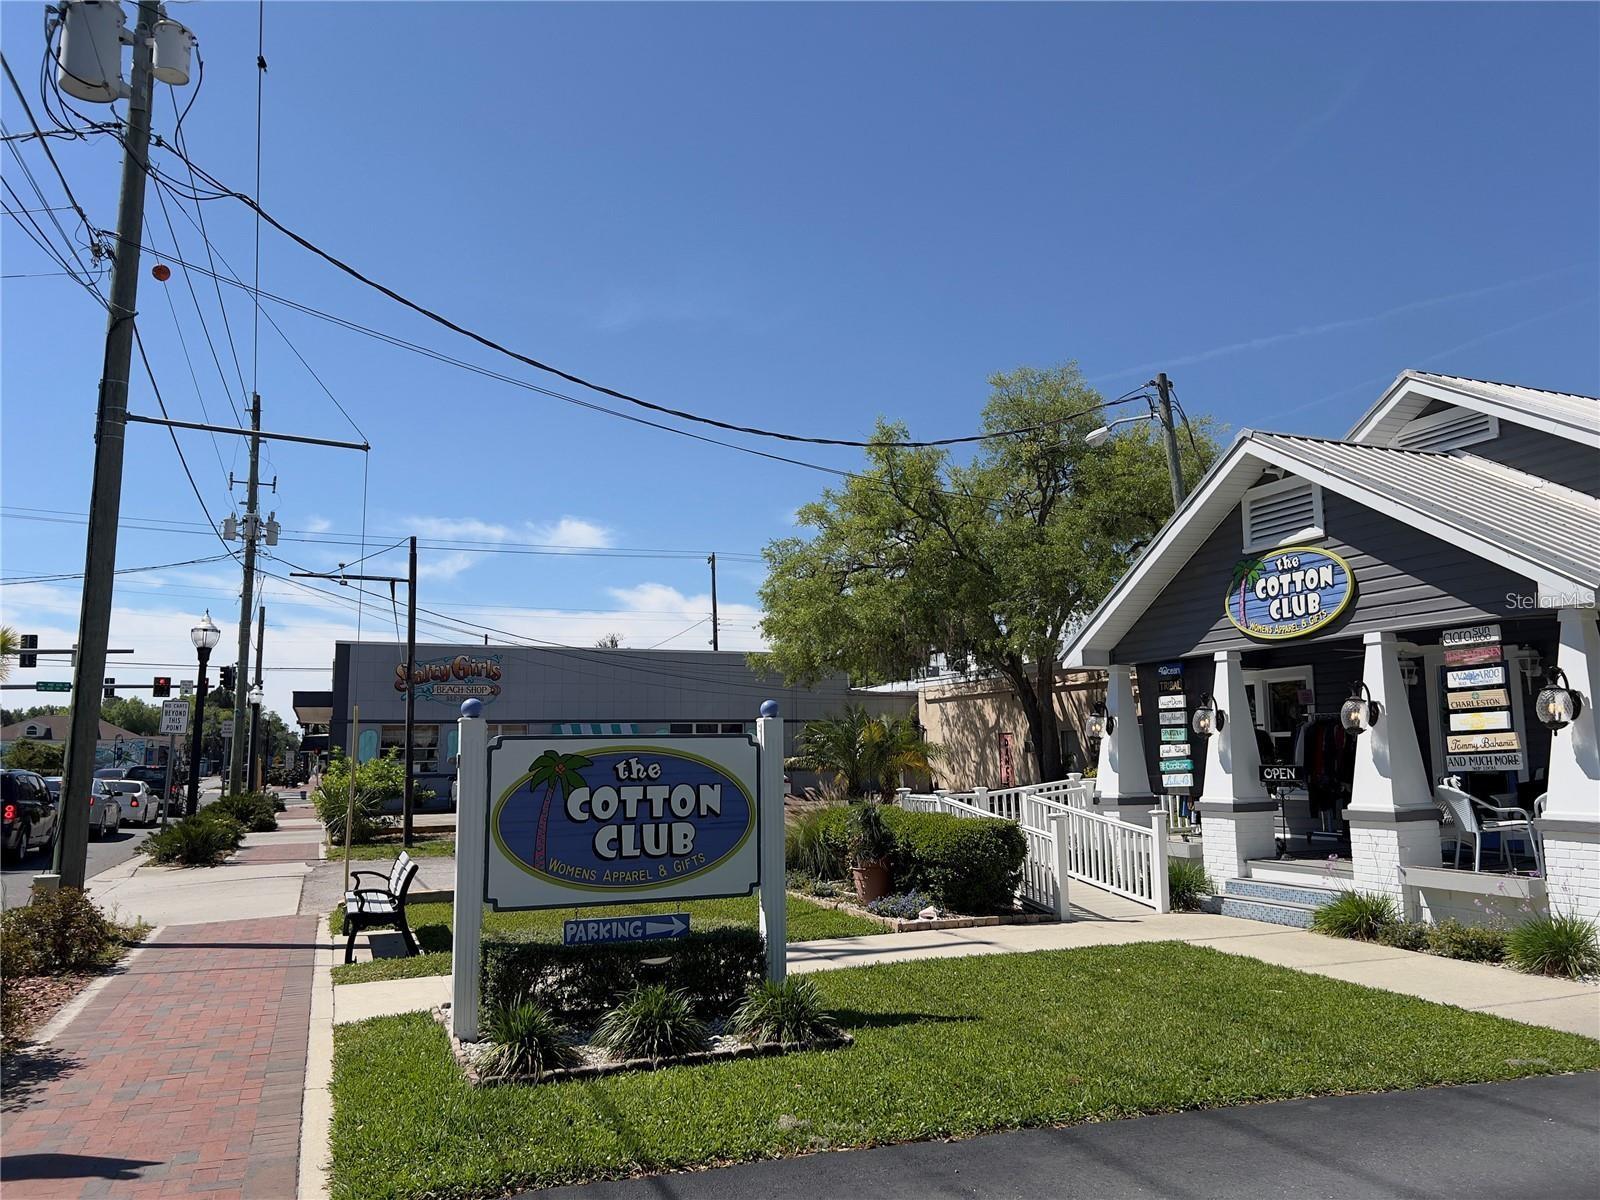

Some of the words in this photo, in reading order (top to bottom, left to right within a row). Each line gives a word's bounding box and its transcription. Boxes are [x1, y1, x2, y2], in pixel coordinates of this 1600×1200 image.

[1275, 555, 1300, 571] the
[1255, 564, 1334, 599] COTTON
[1269, 592, 1320, 620] CLUB
[1274, 622, 1299, 634] APPAREL
[1308, 609, 1328, 625] GIFTS
[1472, 626, 1491, 636] sun
[1472, 632, 1492, 642] woo
[451, 655, 501, 681] Girls
[436, 685, 463, 694] BEACH
[466, 685, 487, 693] SHOP
[1450, 698, 1501, 709] CHARLESTON
[1450, 739, 1480, 751] Tommy
[1480, 737, 1514, 749] Bahama
[616, 757, 662, 780] the
[1448, 757, 1466, 767] AND
[1468, 755, 1493, 767] MUCH
[1494, 754, 1521, 766] MORE
[1264, 767, 1296, 779] OPEN
[566, 783, 723, 821] COTTON
[594, 822, 697, 859] CLUB
[602, 869, 653, 882] APPAREL
[658, 864, 667, 878] &
[673, 852, 706, 873] GIFTS
[565, 920, 644, 943] PARKING
